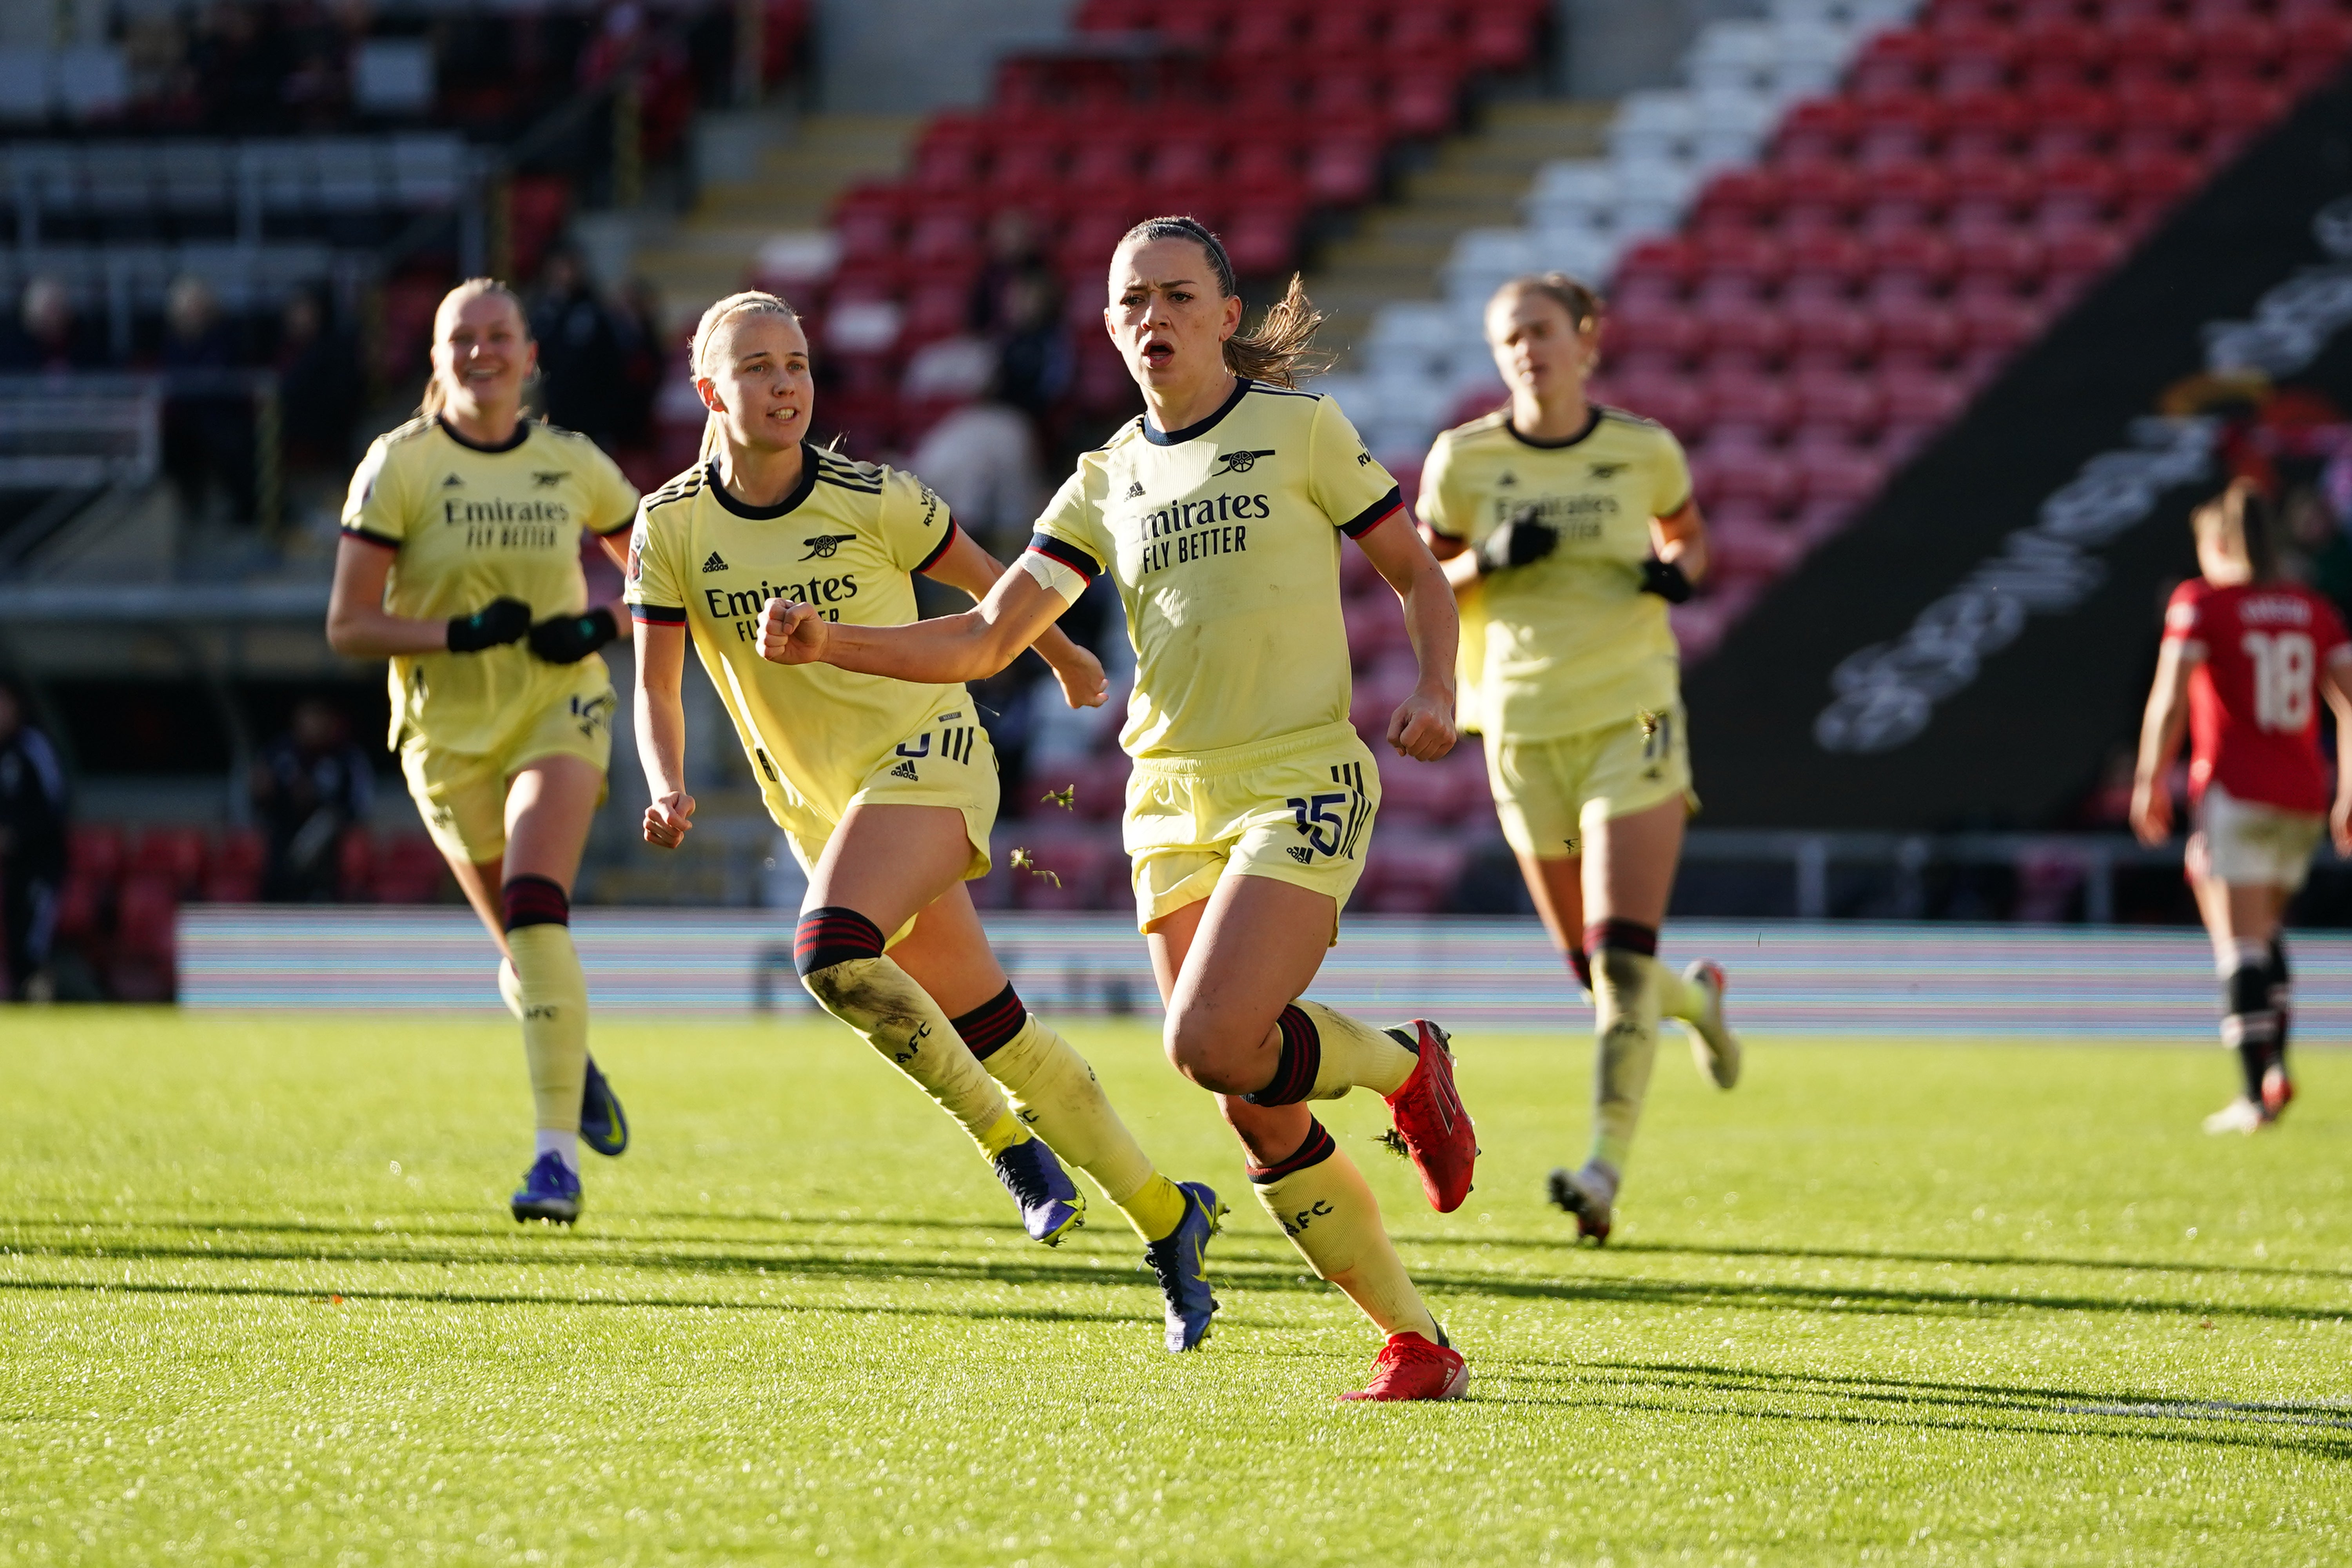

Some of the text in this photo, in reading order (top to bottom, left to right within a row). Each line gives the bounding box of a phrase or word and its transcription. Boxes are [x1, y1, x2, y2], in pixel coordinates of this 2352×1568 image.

[445, 496, 570, 525] Emirates
[702, 563, 729, 573] adidas
[1143, 525, 1247, 574] FLY BETTER
[705, 574, 858, 618] Emirates
[2240, 630, 2316, 732] 18
[891, 768, 919, 782] adidas
[895, 1020, 932, 1063] AFC
[1283, 1199, 1335, 1237] AFC
